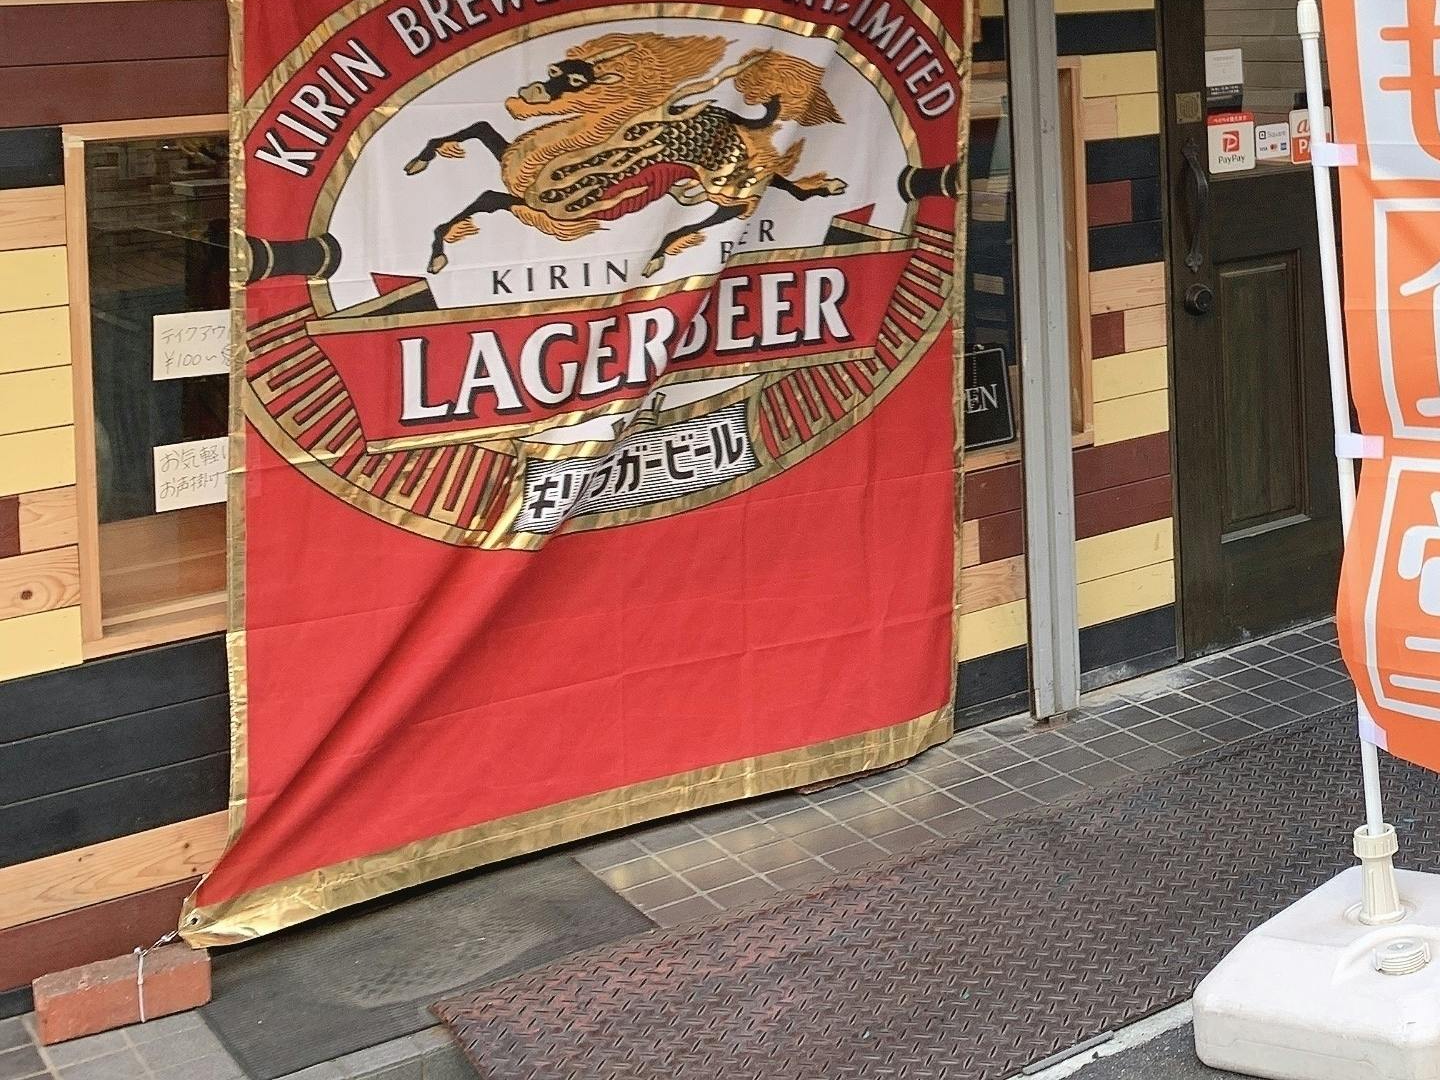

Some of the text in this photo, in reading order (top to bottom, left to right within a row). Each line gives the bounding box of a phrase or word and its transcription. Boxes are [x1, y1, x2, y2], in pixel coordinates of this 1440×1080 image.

[255, 39, 388, 177] KIRIN
[1218, 153, 1246, 164] PayPay
[491, 258, 629, 295] KIRIN
[400, 307, 676, 423] LAGER
[964, 383, 999, 414] EN
